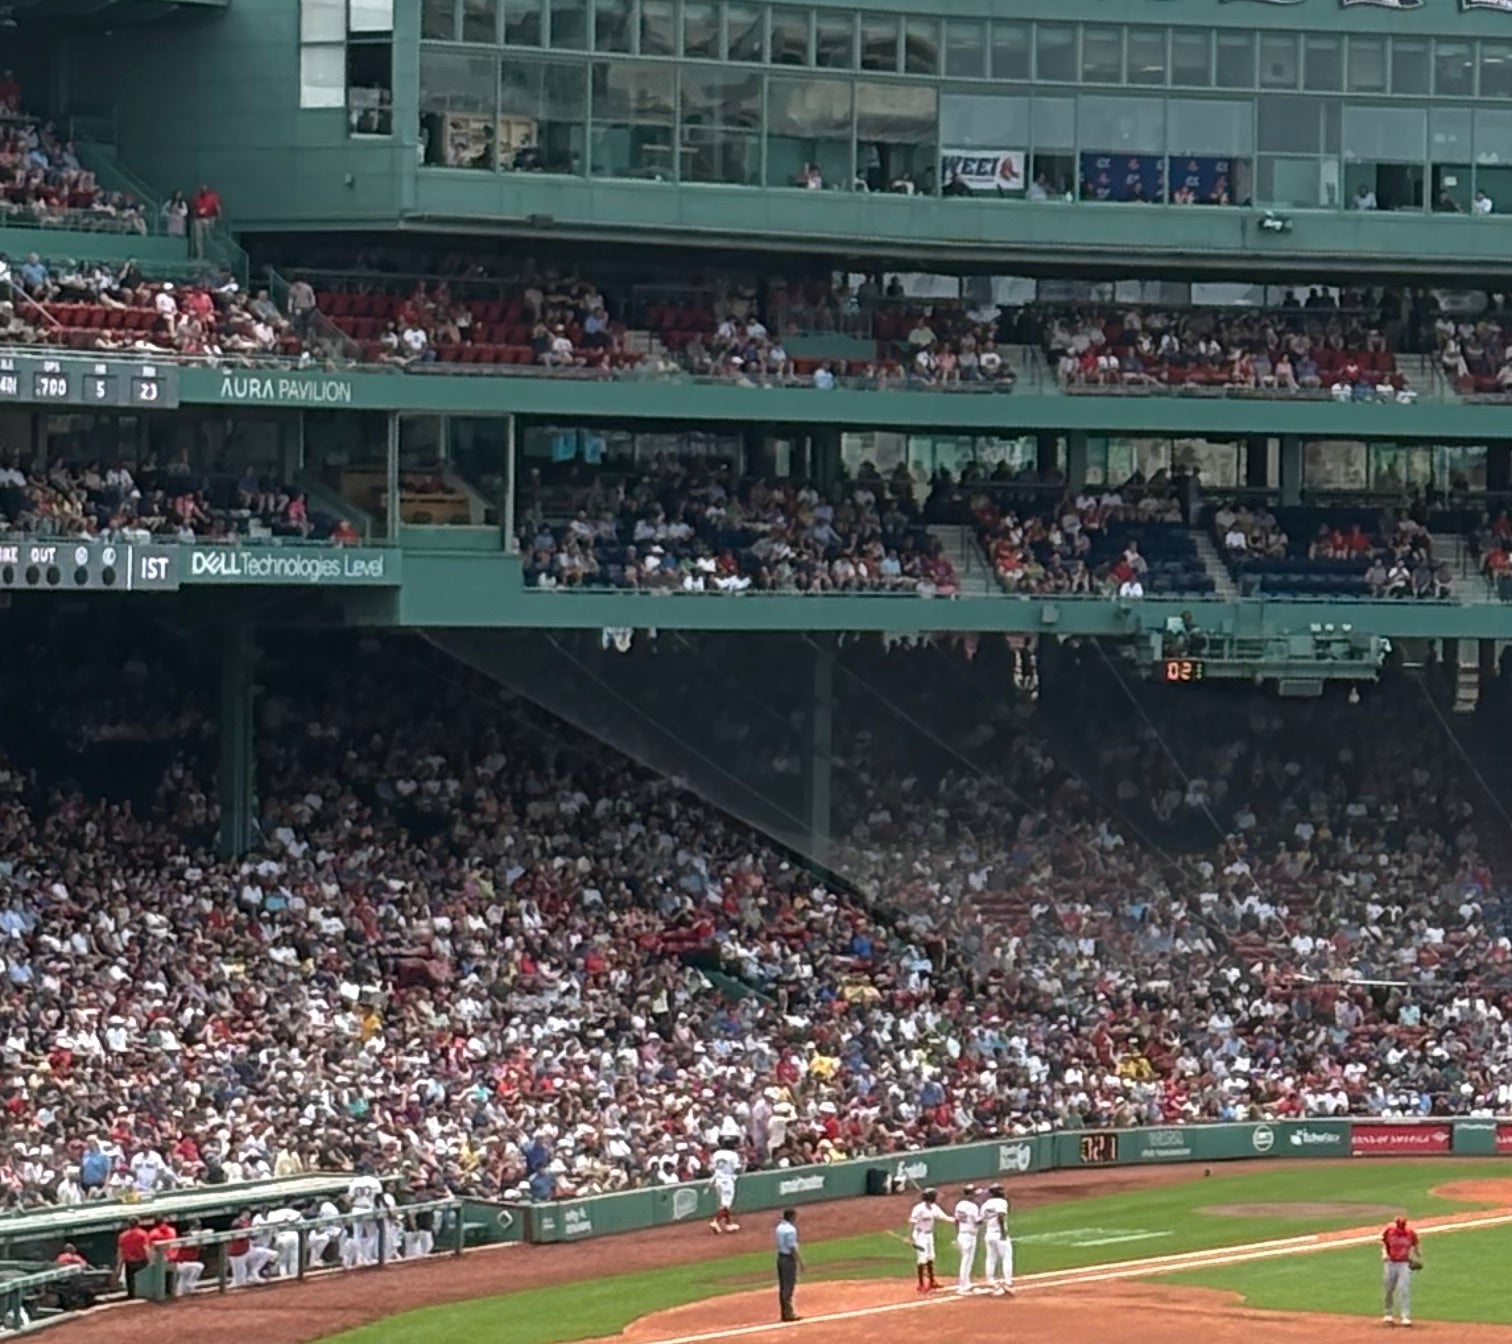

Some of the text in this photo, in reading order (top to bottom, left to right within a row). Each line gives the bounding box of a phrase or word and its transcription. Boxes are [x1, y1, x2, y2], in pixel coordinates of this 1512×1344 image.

[36, 378, 67, 397] .700
[96, 380, 105, 399] 5
[139, 383, 157, 401] 23
[278, 379, 351, 403] PAVILION
[31, 547, 57, 564] OUT
[192, 552, 384, 582] DELL Technologies Level
